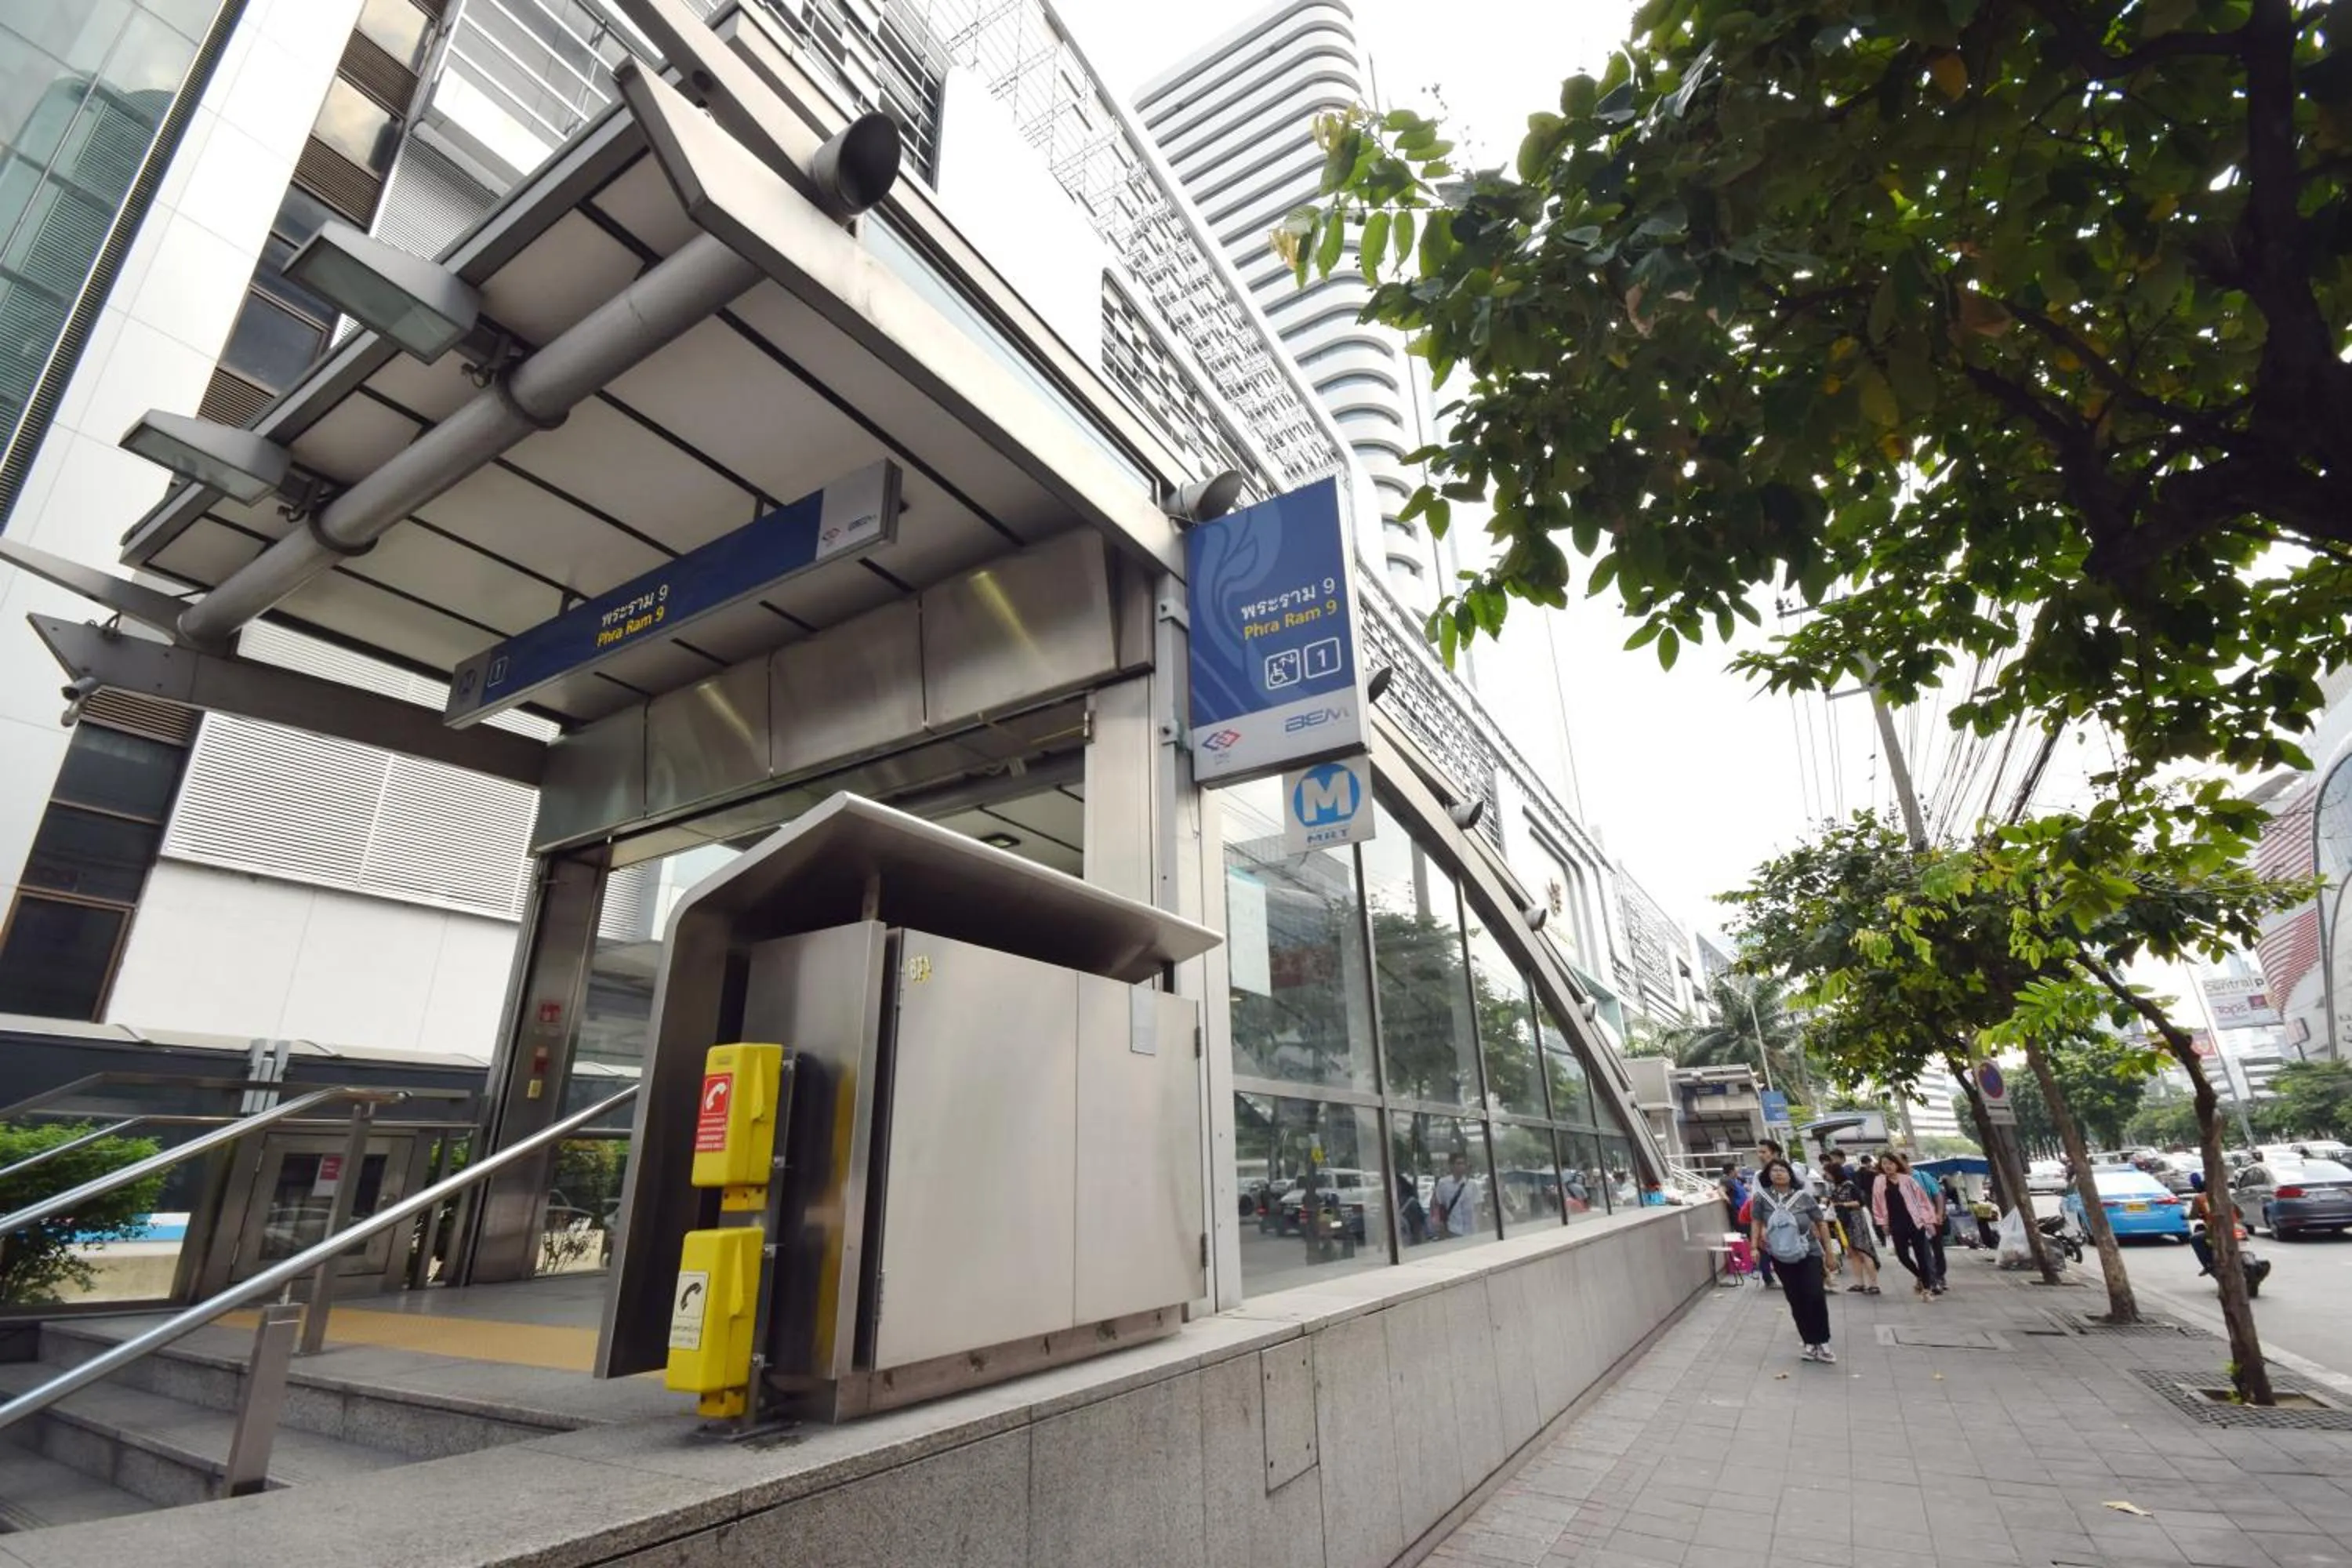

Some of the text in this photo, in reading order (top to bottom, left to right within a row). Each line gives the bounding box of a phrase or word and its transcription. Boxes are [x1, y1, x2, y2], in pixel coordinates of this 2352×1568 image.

[602, 584, 669, 627] พระราม 9
[1241, 576, 1335, 621] พระราม 9
[597, 605, 665, 648] Phra Ram 9
[1244, 599, 1338, 641] Phra Ram 9
[1317, 648, 1327, 668] 1
[1284, 707, 1350, 733] BEM
[1301, 771, 1352, 822] M
[1307, 828, 1349, 844] MRT
